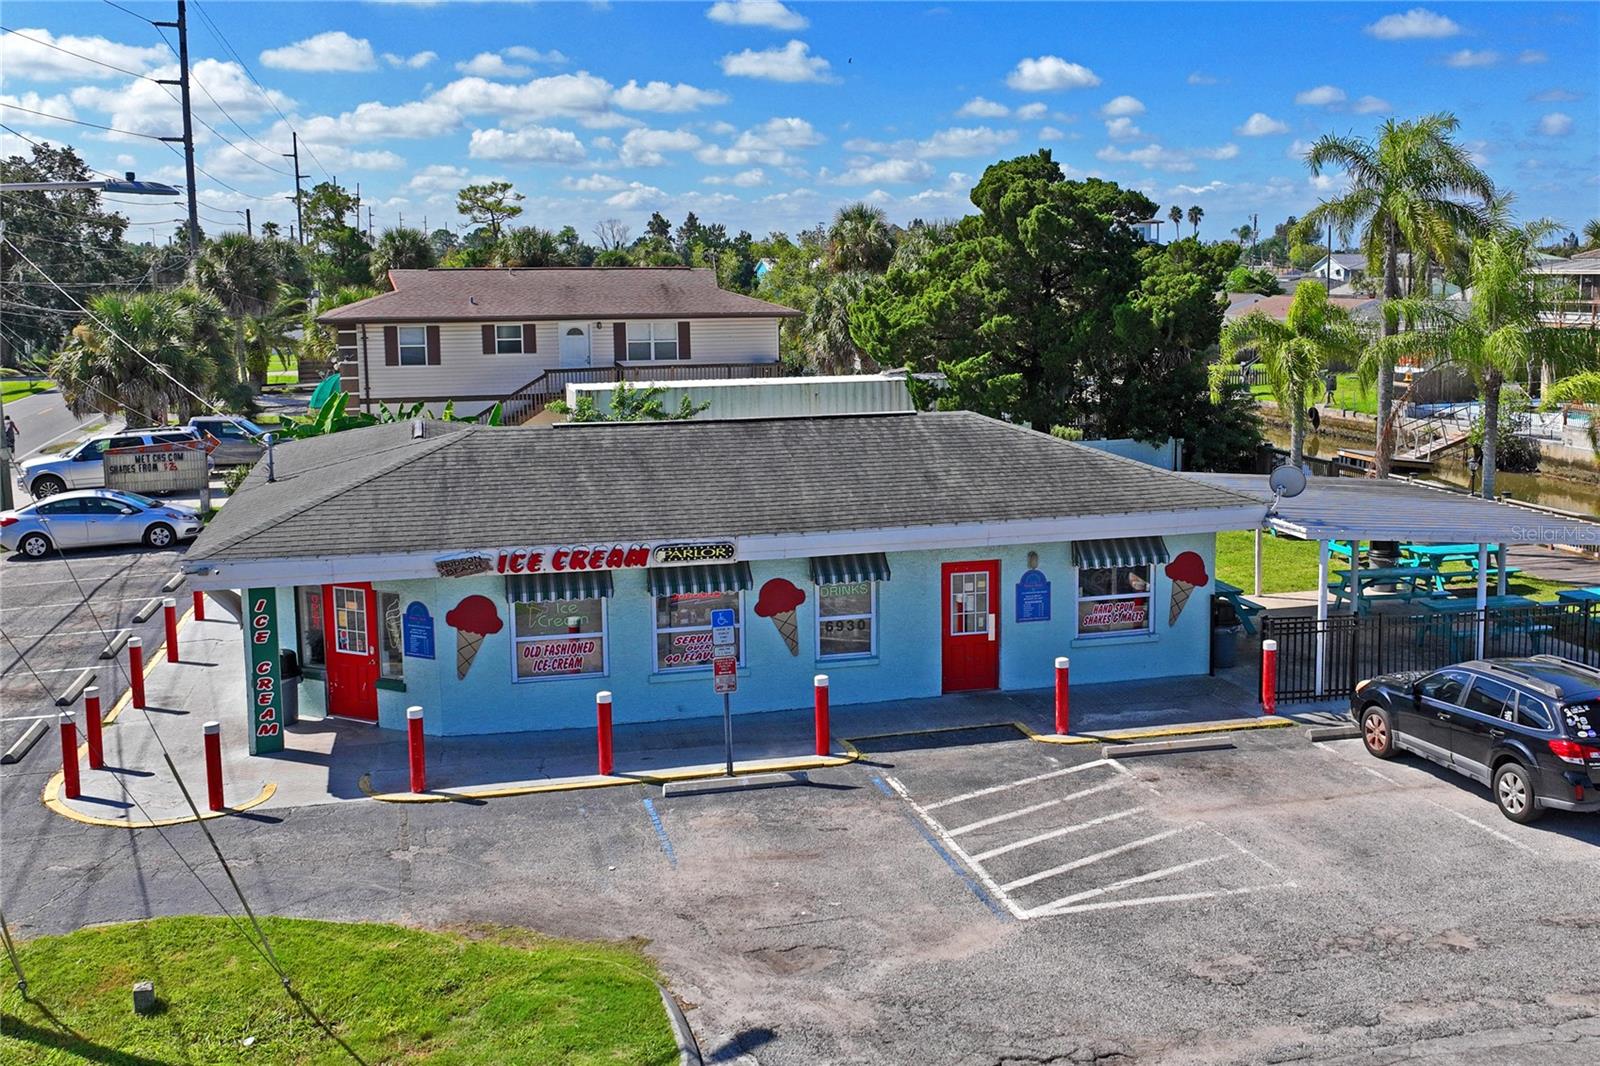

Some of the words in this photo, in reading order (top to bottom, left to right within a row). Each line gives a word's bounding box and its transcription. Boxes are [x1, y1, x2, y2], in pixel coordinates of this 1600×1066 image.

[138, 463, 158, 473] FROM
[497, 549, 546, 574] ICE
[551, 544, 651, 571] CREAM
[663, 546, 727, 560] PARLOR
[440, 555, 483, 569] HUDSON
[445, 561, 483, 577] BEACH
[820, 583, 869, 599] DRINKS
[556, 603, 578, 614] Ice
[1092, 603, 1113, 614] HAND
[1114, 602, 1135, 613] SPUN
[253, 598, 270, 645] ICE
[825, 619, 866, 632] 6930
[1083, 613, 1112, 626] SHAKES
[1120, 610, 1145, 623] MALTS
[674, 633, 712, 646] SERVI
[523, 645, 542, 659] OLD
[543, 641, 595, 657] FASHIONED
[664, 652, 681, 664] 40
[683, 650, 714, 662] FLAV
[533, 656, 584, 673] ICE-CREAM
[256, 660, 279, 737] CREAM
